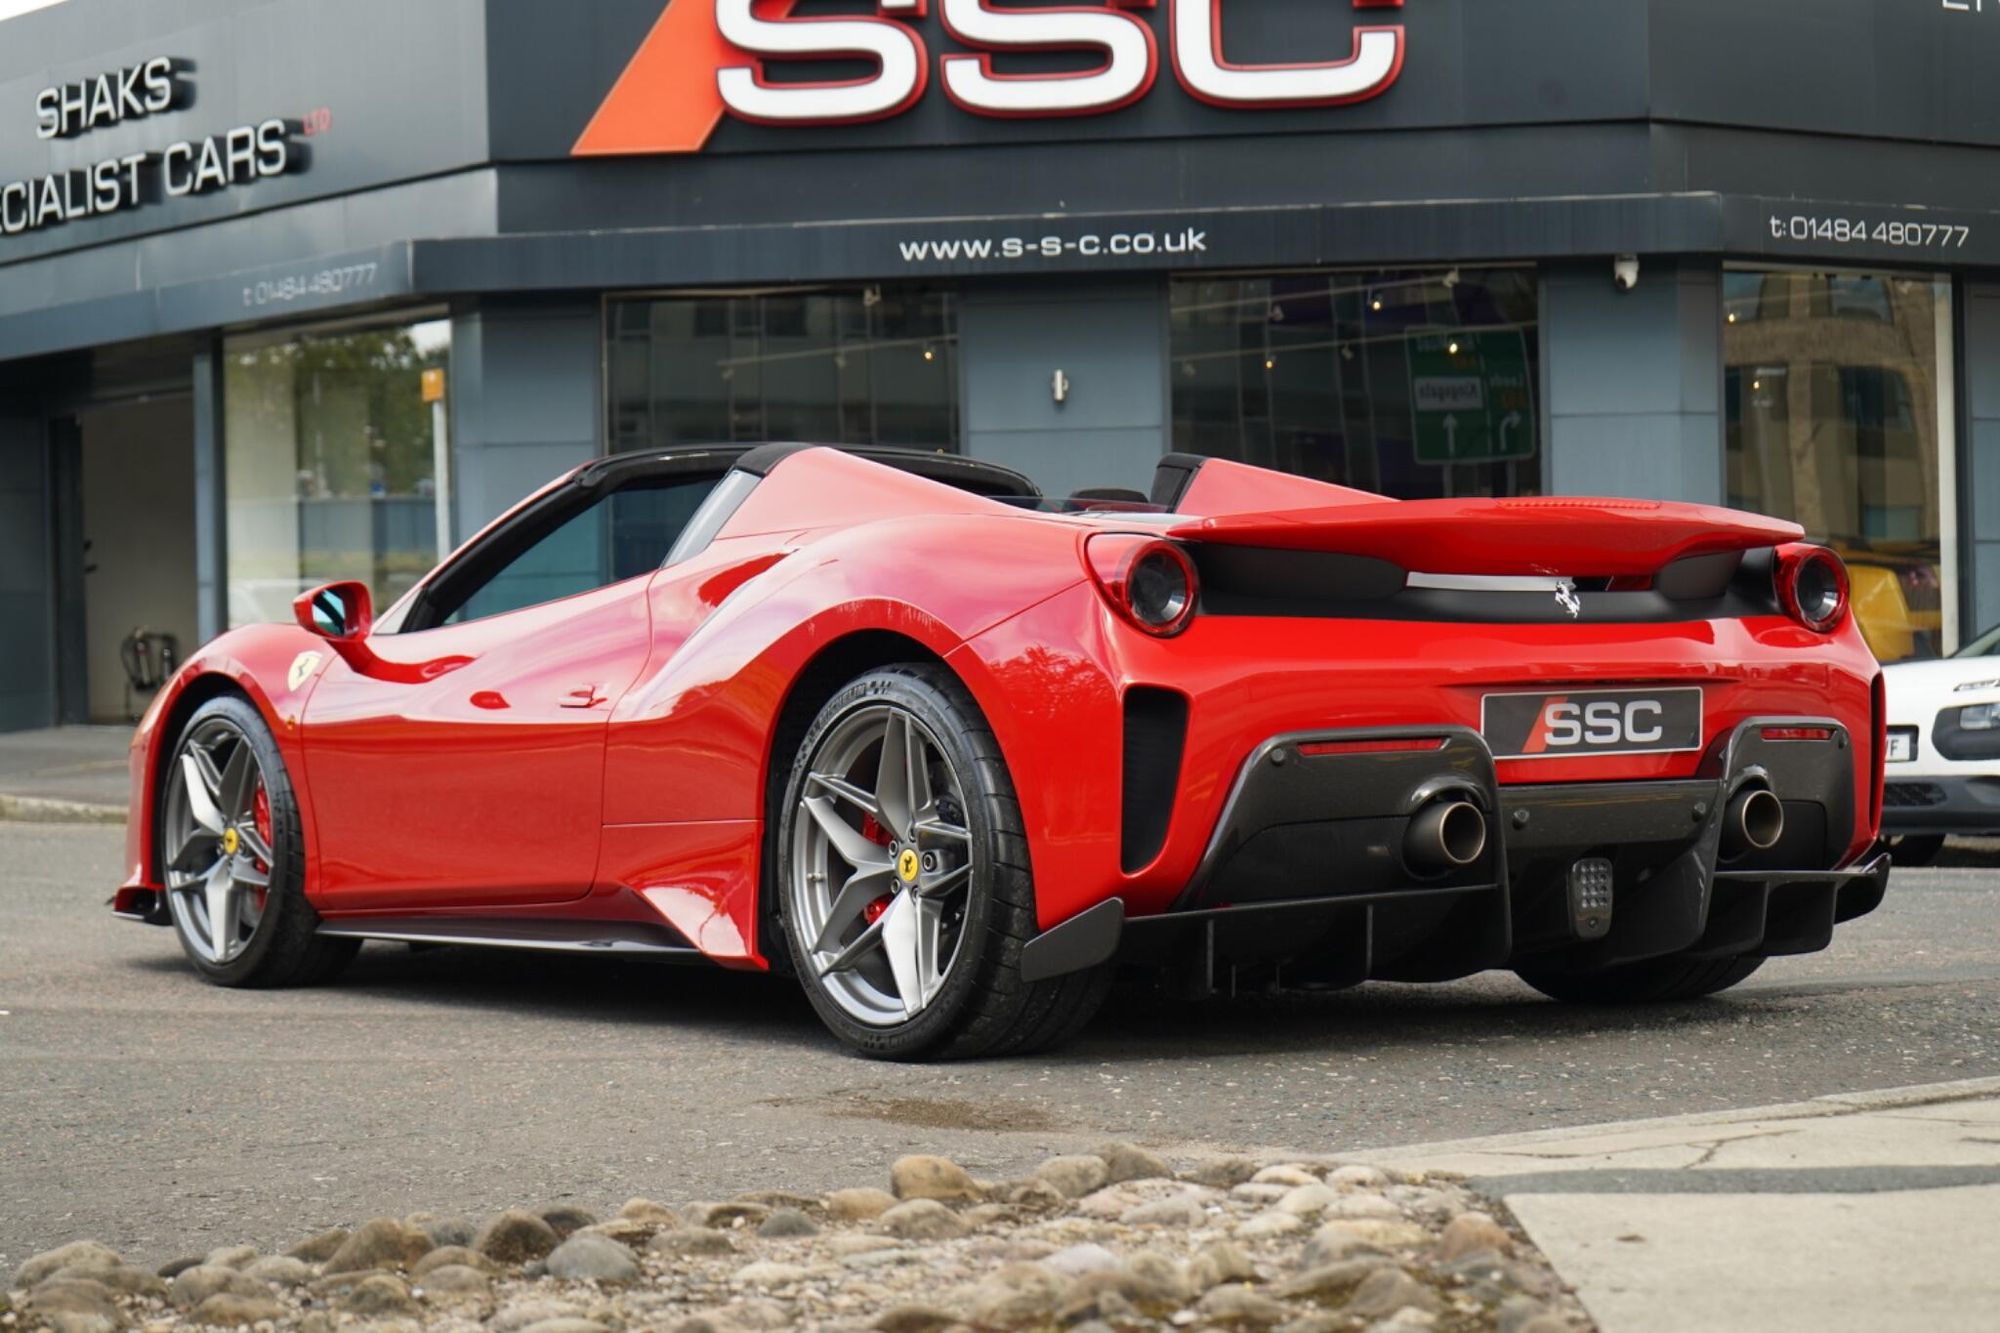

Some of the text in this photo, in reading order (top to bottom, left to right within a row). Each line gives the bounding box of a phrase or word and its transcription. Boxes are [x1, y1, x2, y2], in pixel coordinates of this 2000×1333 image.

[35, 56, 172, 140] SHAKS
[715, 0, 1404, 125] SSC
[163, 118, 286, 196] CARS
[899, 227, 1207, 261] www.s-s-c.co.uk
[1544, 699, 1663, 746] SSC
